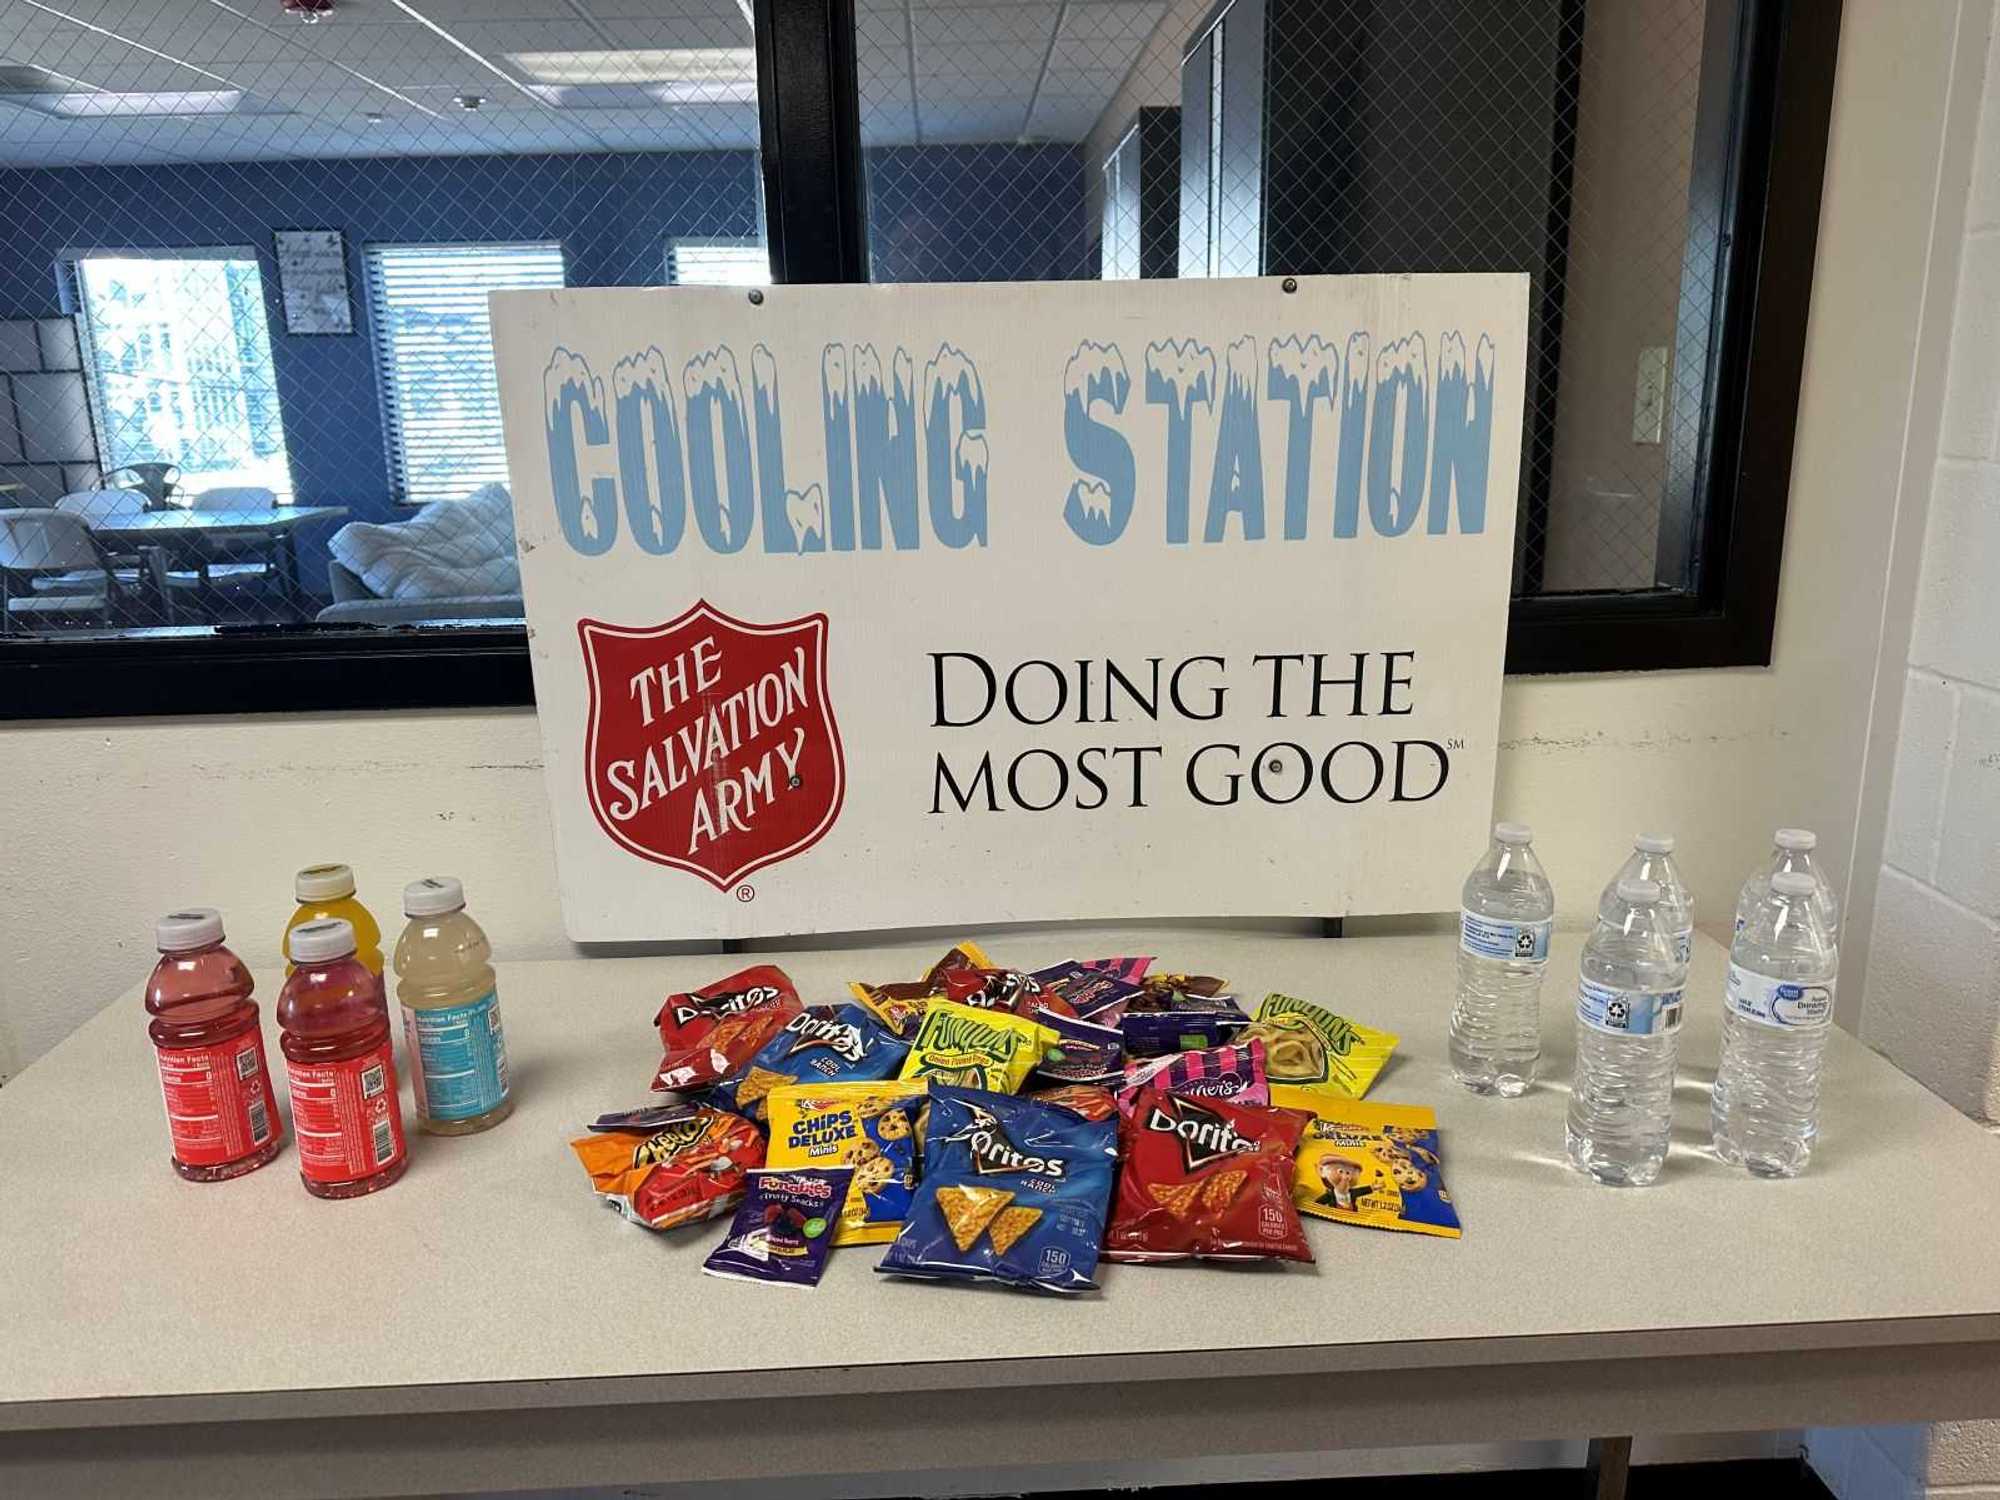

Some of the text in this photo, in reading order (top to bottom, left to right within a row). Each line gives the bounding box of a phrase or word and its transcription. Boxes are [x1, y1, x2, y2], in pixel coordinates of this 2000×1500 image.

[544, 330, 1495, 556] COOLING STATION
[630, 636, 723, 728] THE
[927, 650, 1416, 728] DOING THE
[606, 646, 809, 821] SALVATION
[688, 727, 805, 856] ARMY
[928, 745, 1163, 814] MOST
[1186, 739, 1450, 807] GOOD
[785, 1012, 867, 1062] Doritos
[788, 1125, 857, 1149] DELUXE
[809, 1144, 838, 1158] Minis
[759, 1176, 833, 1199] Funables
